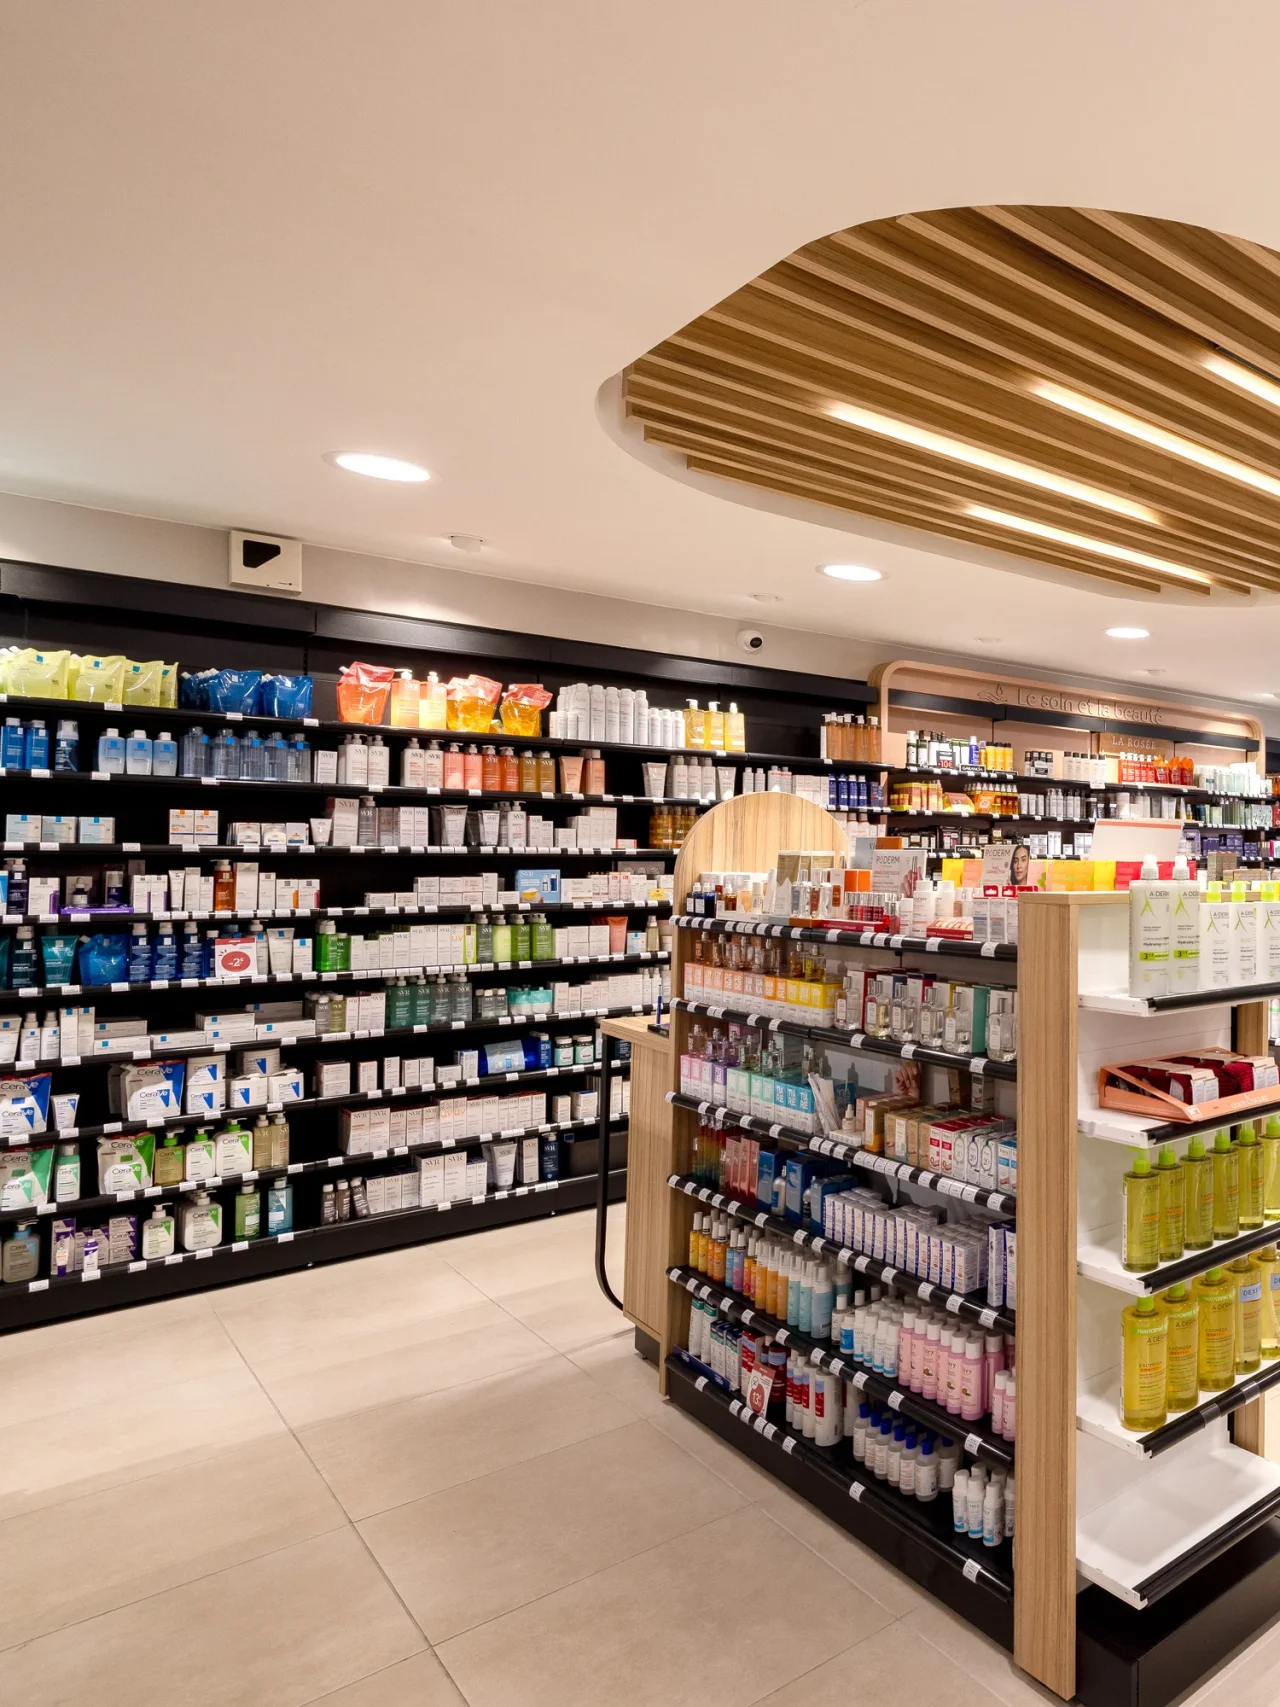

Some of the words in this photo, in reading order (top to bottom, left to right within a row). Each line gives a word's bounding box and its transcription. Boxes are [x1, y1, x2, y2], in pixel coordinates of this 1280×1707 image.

[1016, 688, 1038, 707] Le
[1040, 694, 1074, 712] soin
[1077, 698, 1094, 716] et
[1097, 699, 1111, 718] la
[1113, 702, 1164, 725] beauté
[1112, 736, 1125, 746] LA
[1126, 737, 1157, 750] ROSÉE
[137, 1066, 172, 1076] CeraVe
[1, 1081, 38, 1091] CeraVe
[2, 1108, 34, 1117] CeraVe
[111, 1139, 144, 1149] CeraVe
[222, 1136, 248, 1145] CeraVe
[2, 1153, 39, 1163] CeraVe
[112, 1165, 140, 1175] CeraVe
[2, 1181, 31, 1190] CeraVe
[193, 1210, 217, 1219] CeraVe
